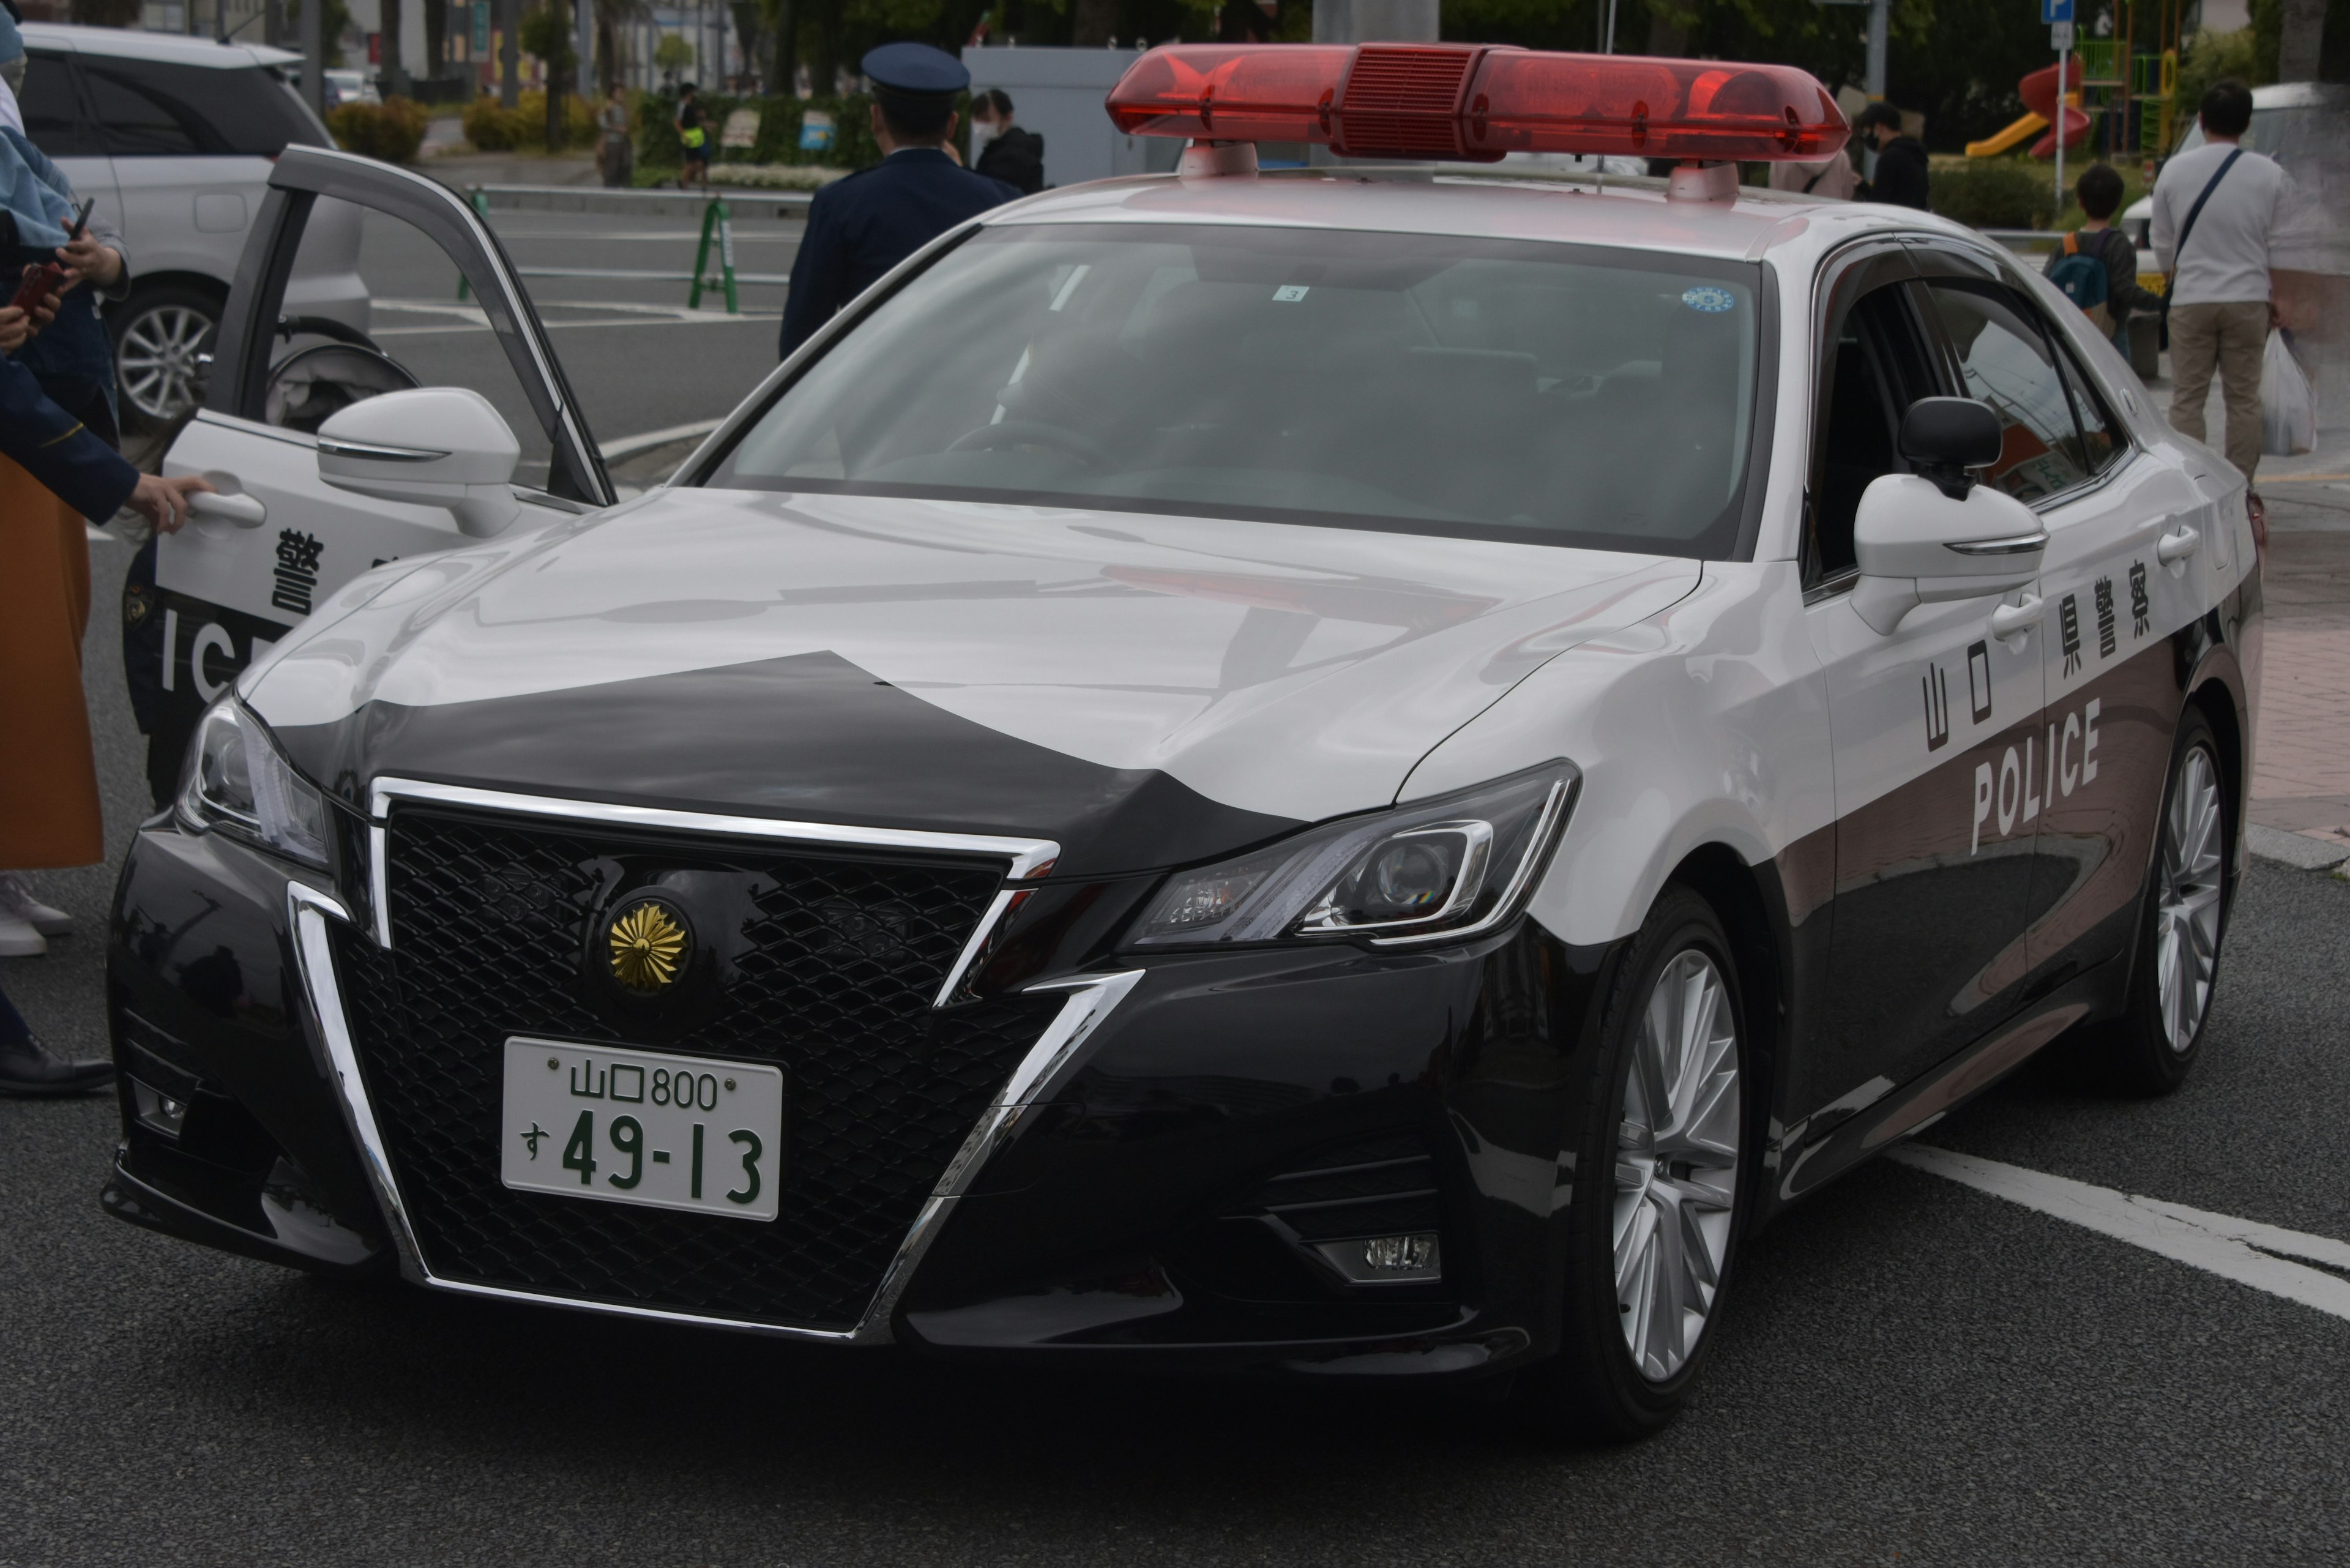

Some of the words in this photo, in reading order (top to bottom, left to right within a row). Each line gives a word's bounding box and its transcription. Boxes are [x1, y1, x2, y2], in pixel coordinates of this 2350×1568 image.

[1286, 291, 1299, 299] 3
[1971, 697, 2100, 856] POLICE
[520, 1122, 550, 1160] す
[563, 1110, 763, 1204] 49-13
